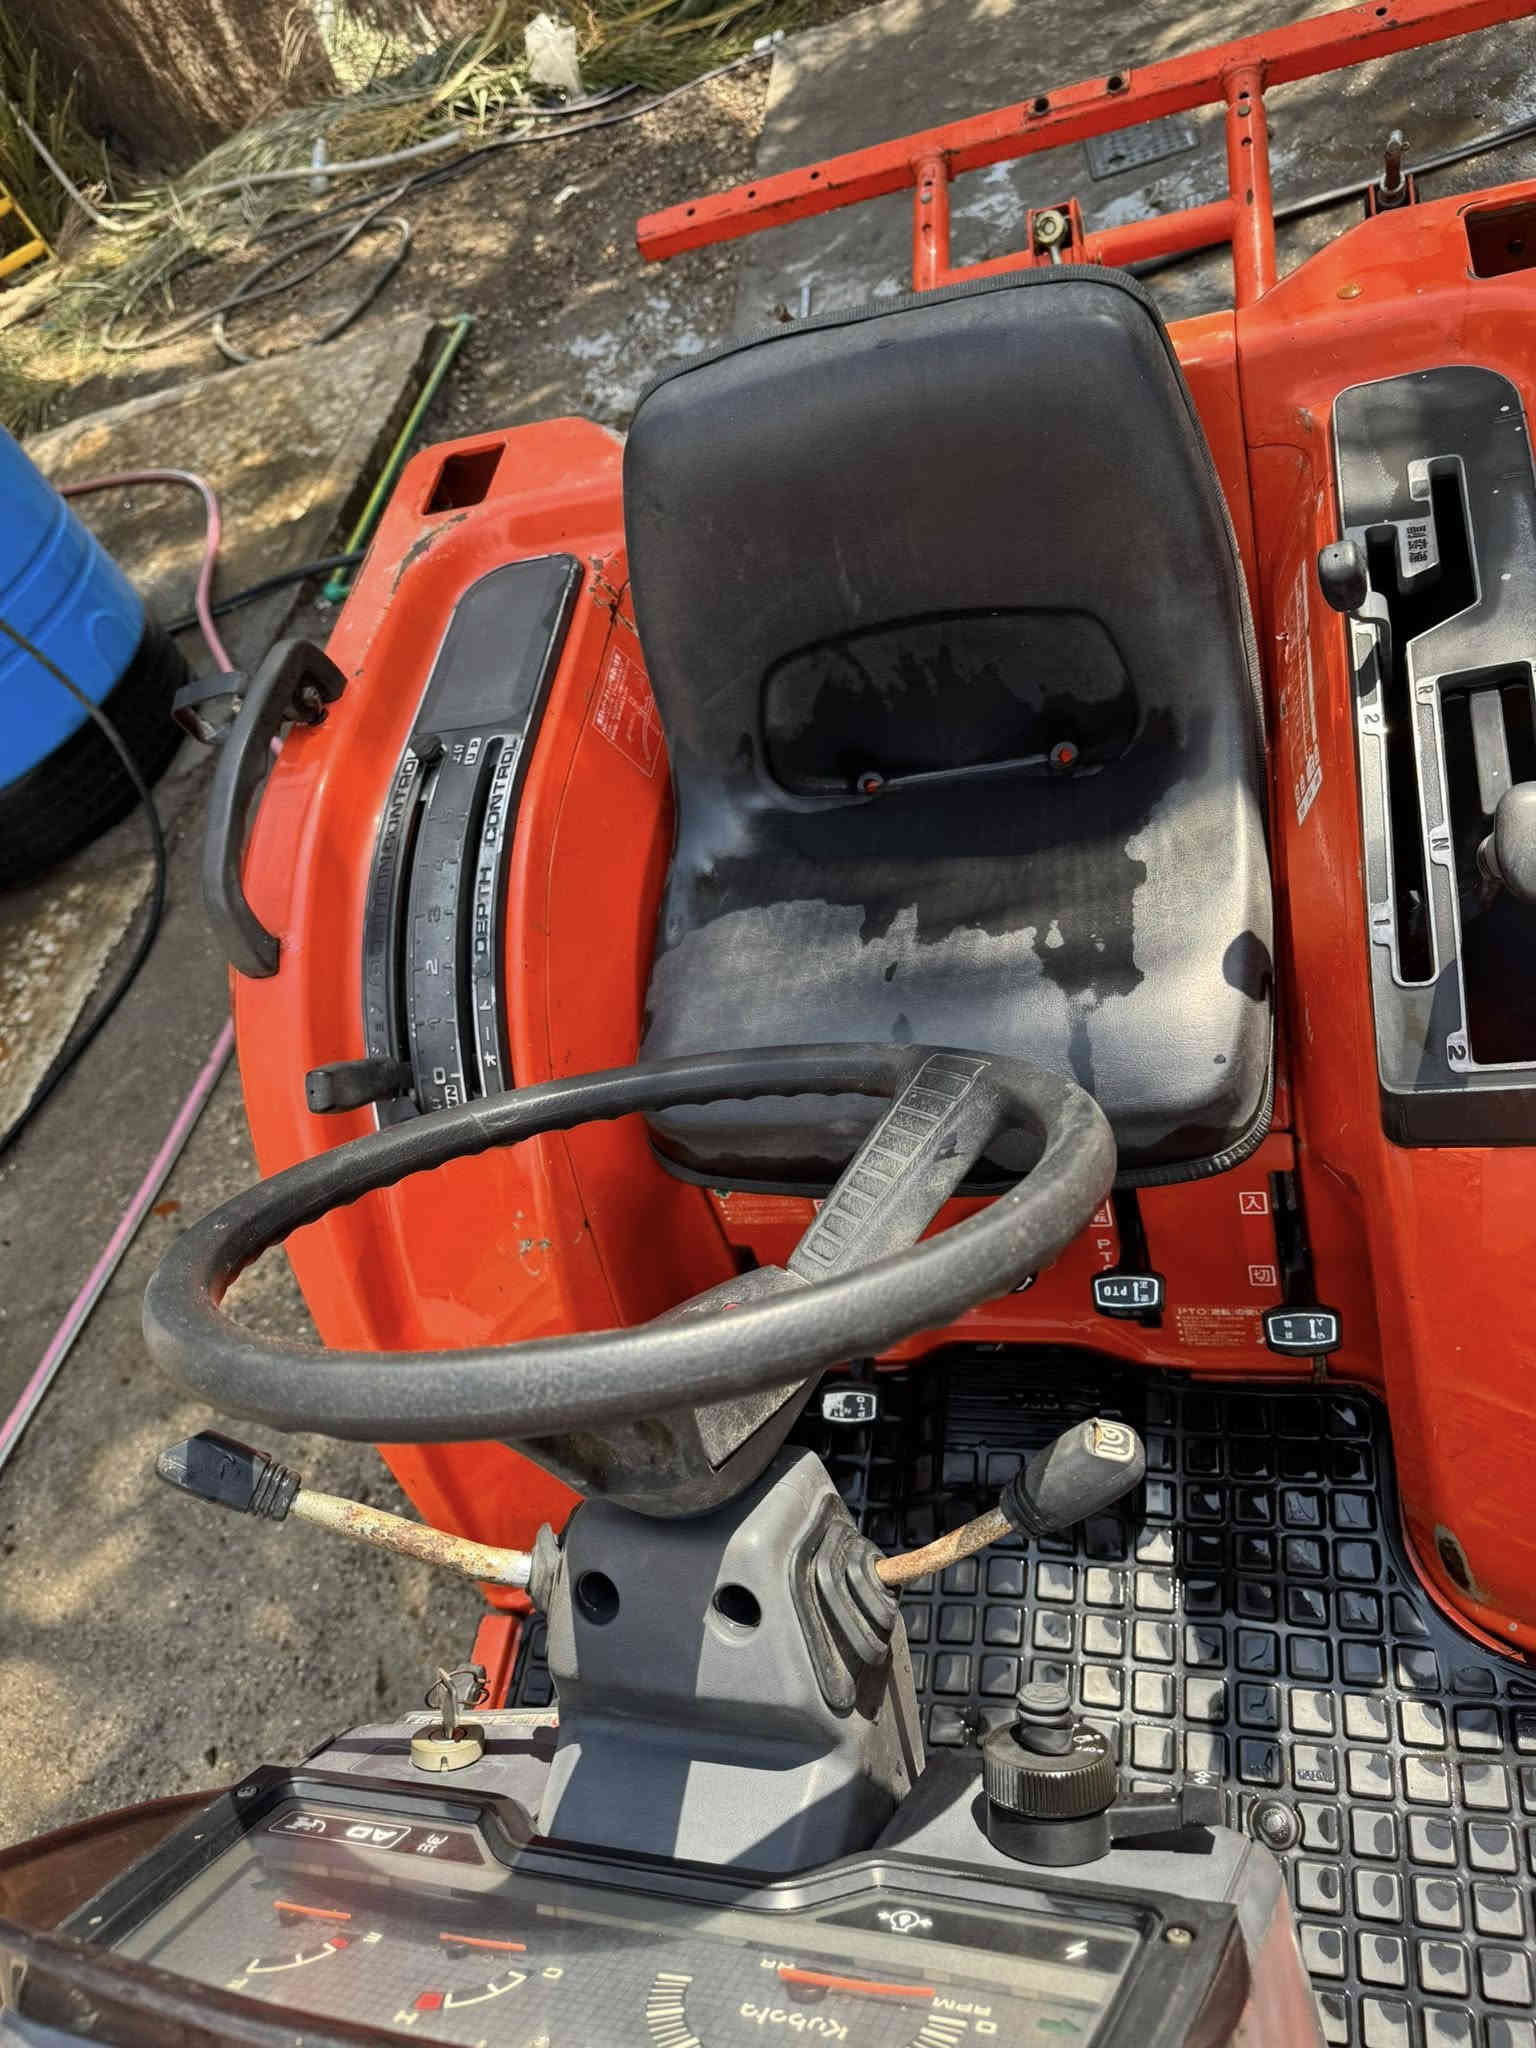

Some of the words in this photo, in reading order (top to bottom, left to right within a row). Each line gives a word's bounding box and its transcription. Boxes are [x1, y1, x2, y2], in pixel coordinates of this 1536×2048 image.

[1417, 685, 1433, 697] R
[1364, 712, 1380, 725] 2
[467, 740, 480, 764] UP
[474, 866, 492, 956] DEPTH
[484, 743, 518, 846] CONTROL
[1432, 836, 1450, 851] N
[426, 959, 439, 975] 2
[1448, 1045, 1466, 1060] 2
[432, 1066, 446, 1084] 0
[1096, 1239, 1114, 1271] PT
[1103, 1285, 1128, 1297] PTO
[345, 1825, 398, 1846] AD
[362, 1931, 383, 1944] E
[932, 1996, 993, 2017] RPM
[740, 2002, 849, 2040] Kubota
